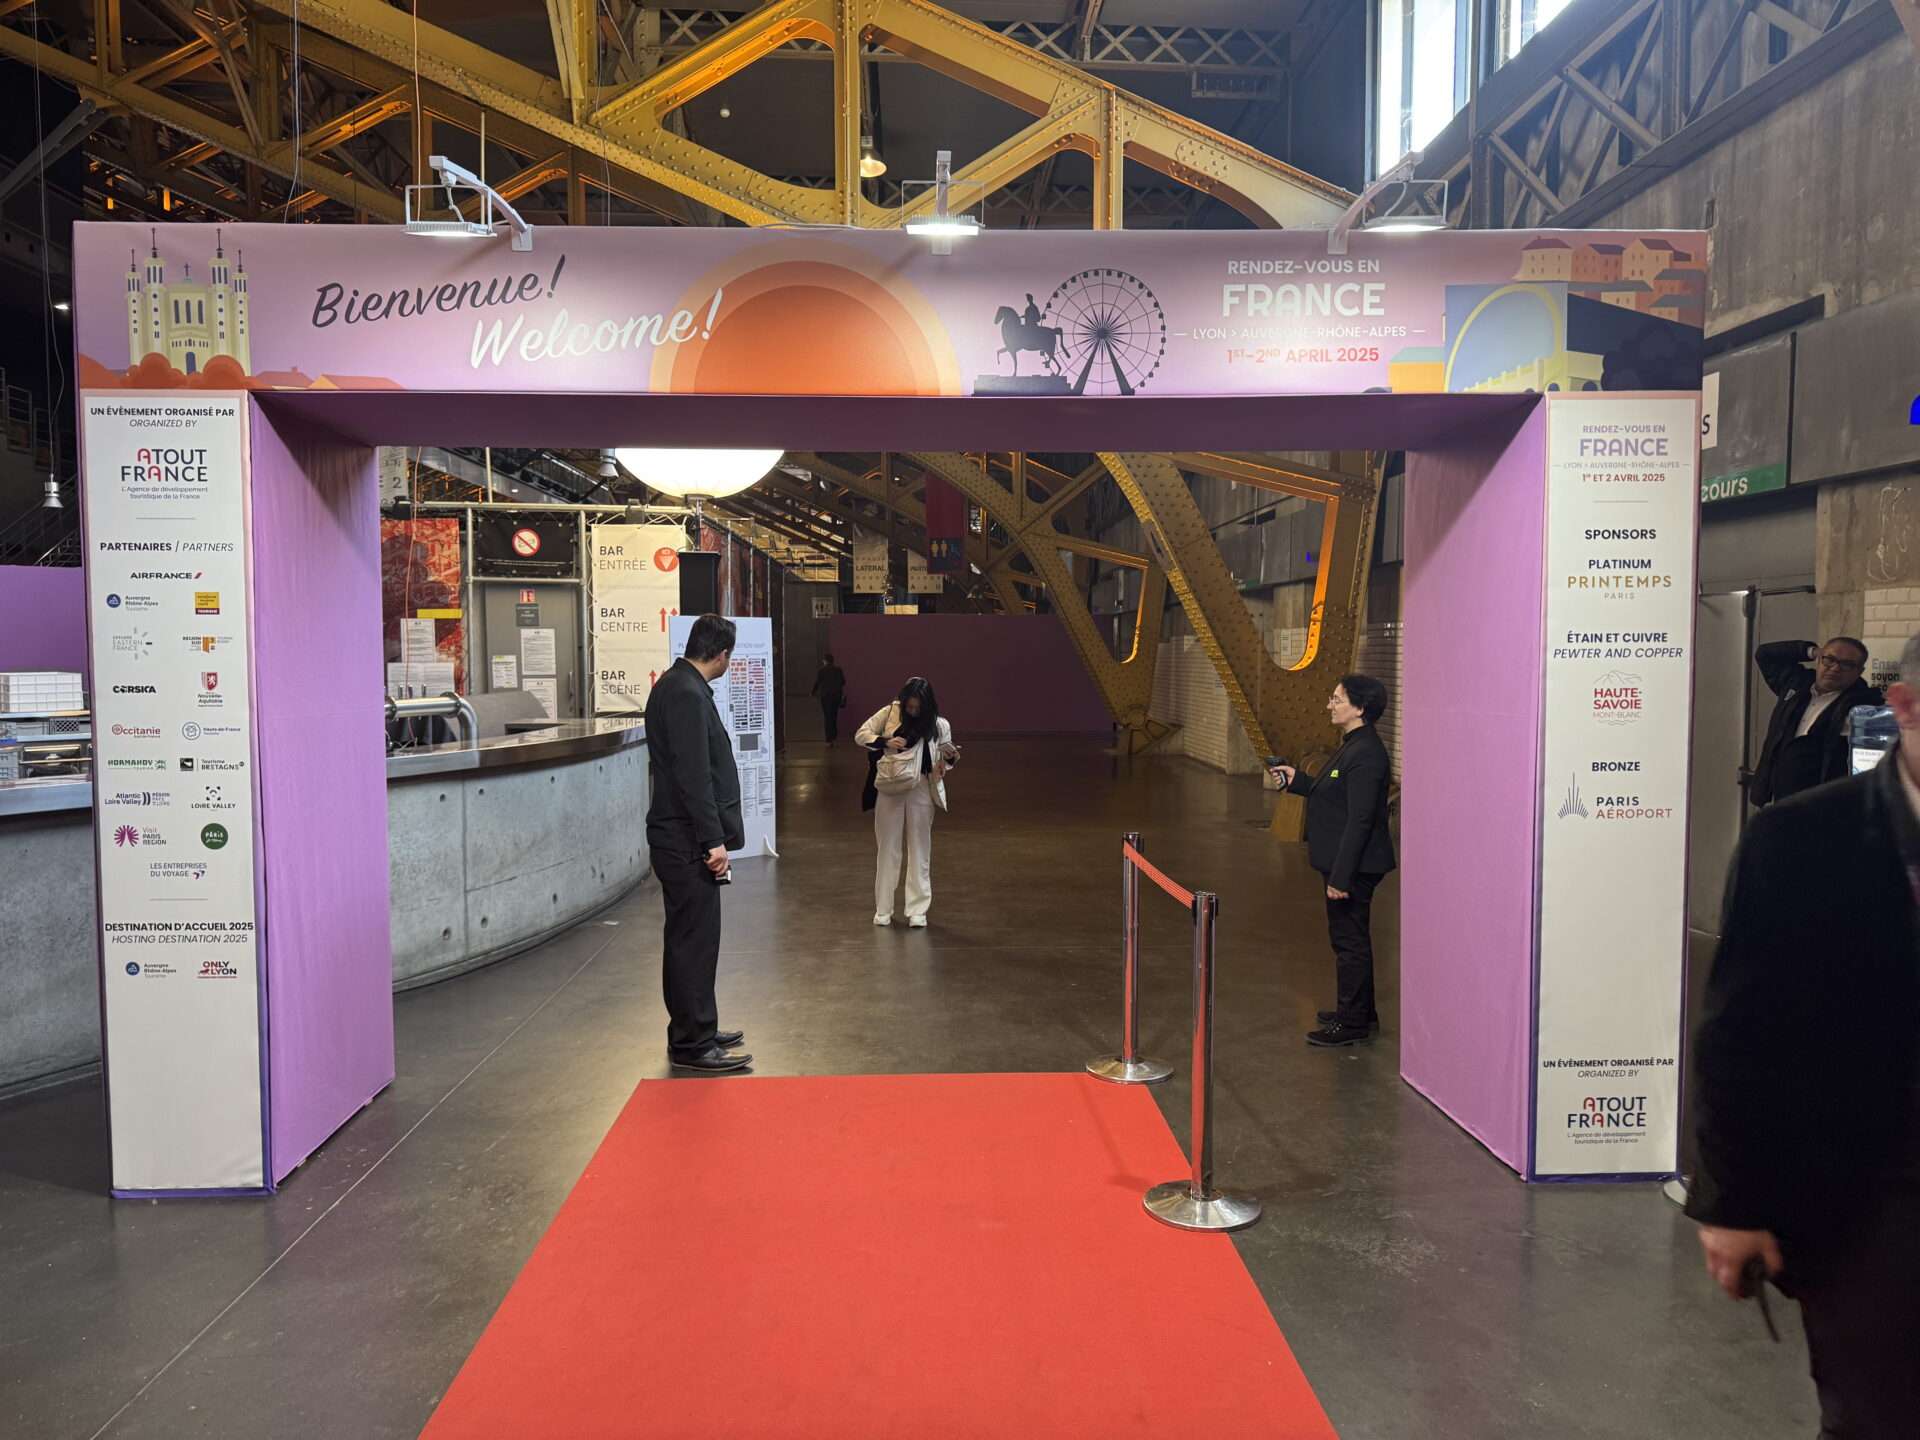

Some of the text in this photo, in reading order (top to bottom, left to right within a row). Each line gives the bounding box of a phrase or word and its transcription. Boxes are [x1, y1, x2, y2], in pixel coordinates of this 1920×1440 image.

[1227, 259, 1380, 275] RENDEZ-VOUS EN
[311, 253, 566, 329] Bienvenue!
[1222, 282, 1385, 317] FRANCE
[470, 286, 724, 370] Welcome!
[1193, 327, 1227, 339] LYON
[1286, 348, 1333, 363] APRIL
[1337, 347, 1380, 363] 2025
[90, 407, 105, 416] UN
[165, 406, 214, 417] ORGANISÉ
[215, 408, 235, 417] PAR
[129, 419, 198, 428] ORGANIZED BY
[1583, 424, 1666, 433] RENDEZ-VOUS EN
[1579, 438, 1669, 456] FRANCE
[137, 448, 207, 465] ATOUT
[121, 465, 208, 482] FRANCE
[1593, 473, 1603, 482] ET
[1606, 473, 1612, 482] 2
[1614, 473, 1640, 482] AVRIL
[1641, 473, 1665, 482] 2025
[1584, 529, 1657, 540] SPONSORS
[100, 541, 172, 551] PARTENAIRES
[182, 542, 234, 552] PARTNERS
[600, 546, 623, 555] BAR
[599, 556, 647, 571] ENTRÉE
[1588, 559, 1652, 569] PLATINUM
[1567, 575, 1672, 588] PRINTEMPS
[1604, 592, 1635, 600] PARIS
[601, 608, 624, 618] BAR
[600, 622, 648, 632] CENTRE
[1567, 630, 1668, 643] ÉTAIN ET CUIVRE
[1553, 647, 1683, 659] PEWTER AND COPPER
[601, 670, 626, 680] BAR
[1593, 687, 1643, 698] HAUTE-
[1593, 698, 1642, 710] SAVOIE
[1593, 711, 1641, 719] MONT-BLANC
[1591, 761, 1640, 772] BRONZE
[1596, 796, 1640, 807] PARIS
[1596, 807, 1673, 819] AÉROPORT
[105, 922, 254, 932] DESTINATION D'ACCUEIL 2025
[112, 934, 248, 944] HOSTING DESTINATION 2025
[1543, 1060, 1556, 1068] UN
[1610, 1057, 1655, 1067] ORGANISÉ
[1656, 1058, 1674, 1066] PAR
[1577, 1069, 1639, 1078] ORGANIZED BY
[1583, 1096, 1647, 1112] ATOUT
[1567, 1112, 1647, 1128] FRANCE
